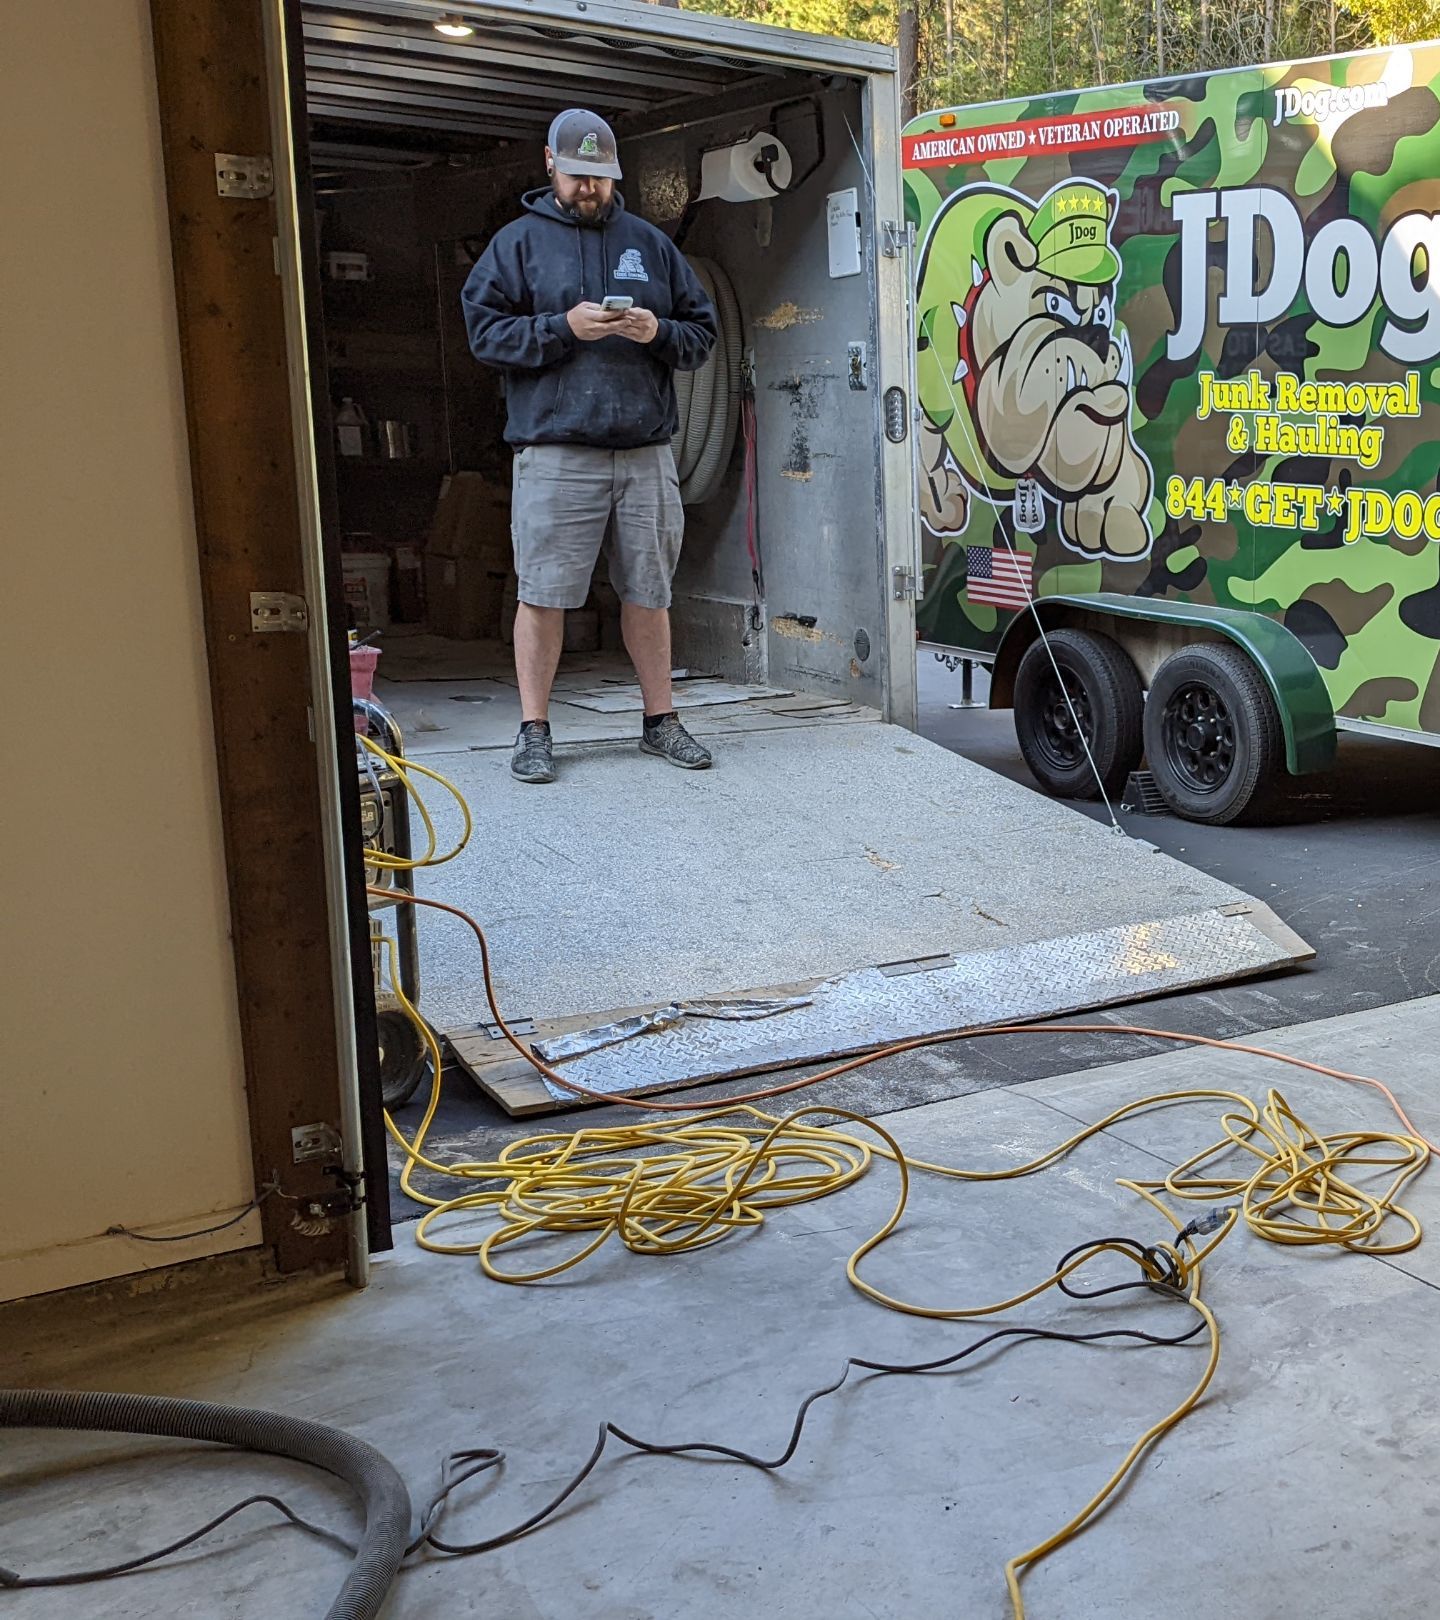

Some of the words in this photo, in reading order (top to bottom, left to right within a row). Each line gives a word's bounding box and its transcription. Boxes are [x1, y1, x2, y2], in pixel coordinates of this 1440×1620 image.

[1272, 81, 1389, 127] JDog.com
[912, 135, 976, 161] AMERICAN
[977, 130, 1026, 152] OWNED
[1038, 120, 1101, 147] VETERAN
[1103, 110, 1181, 138] OPERATED
[1068, 222, 1097, 245] JDog
[1198, 370, 1273, 418] Junk
[1277, 371, 1421, 417] Removal
[1226, 417, 1250, 454] &
[1255, 415, 1384, 467] Hauling
